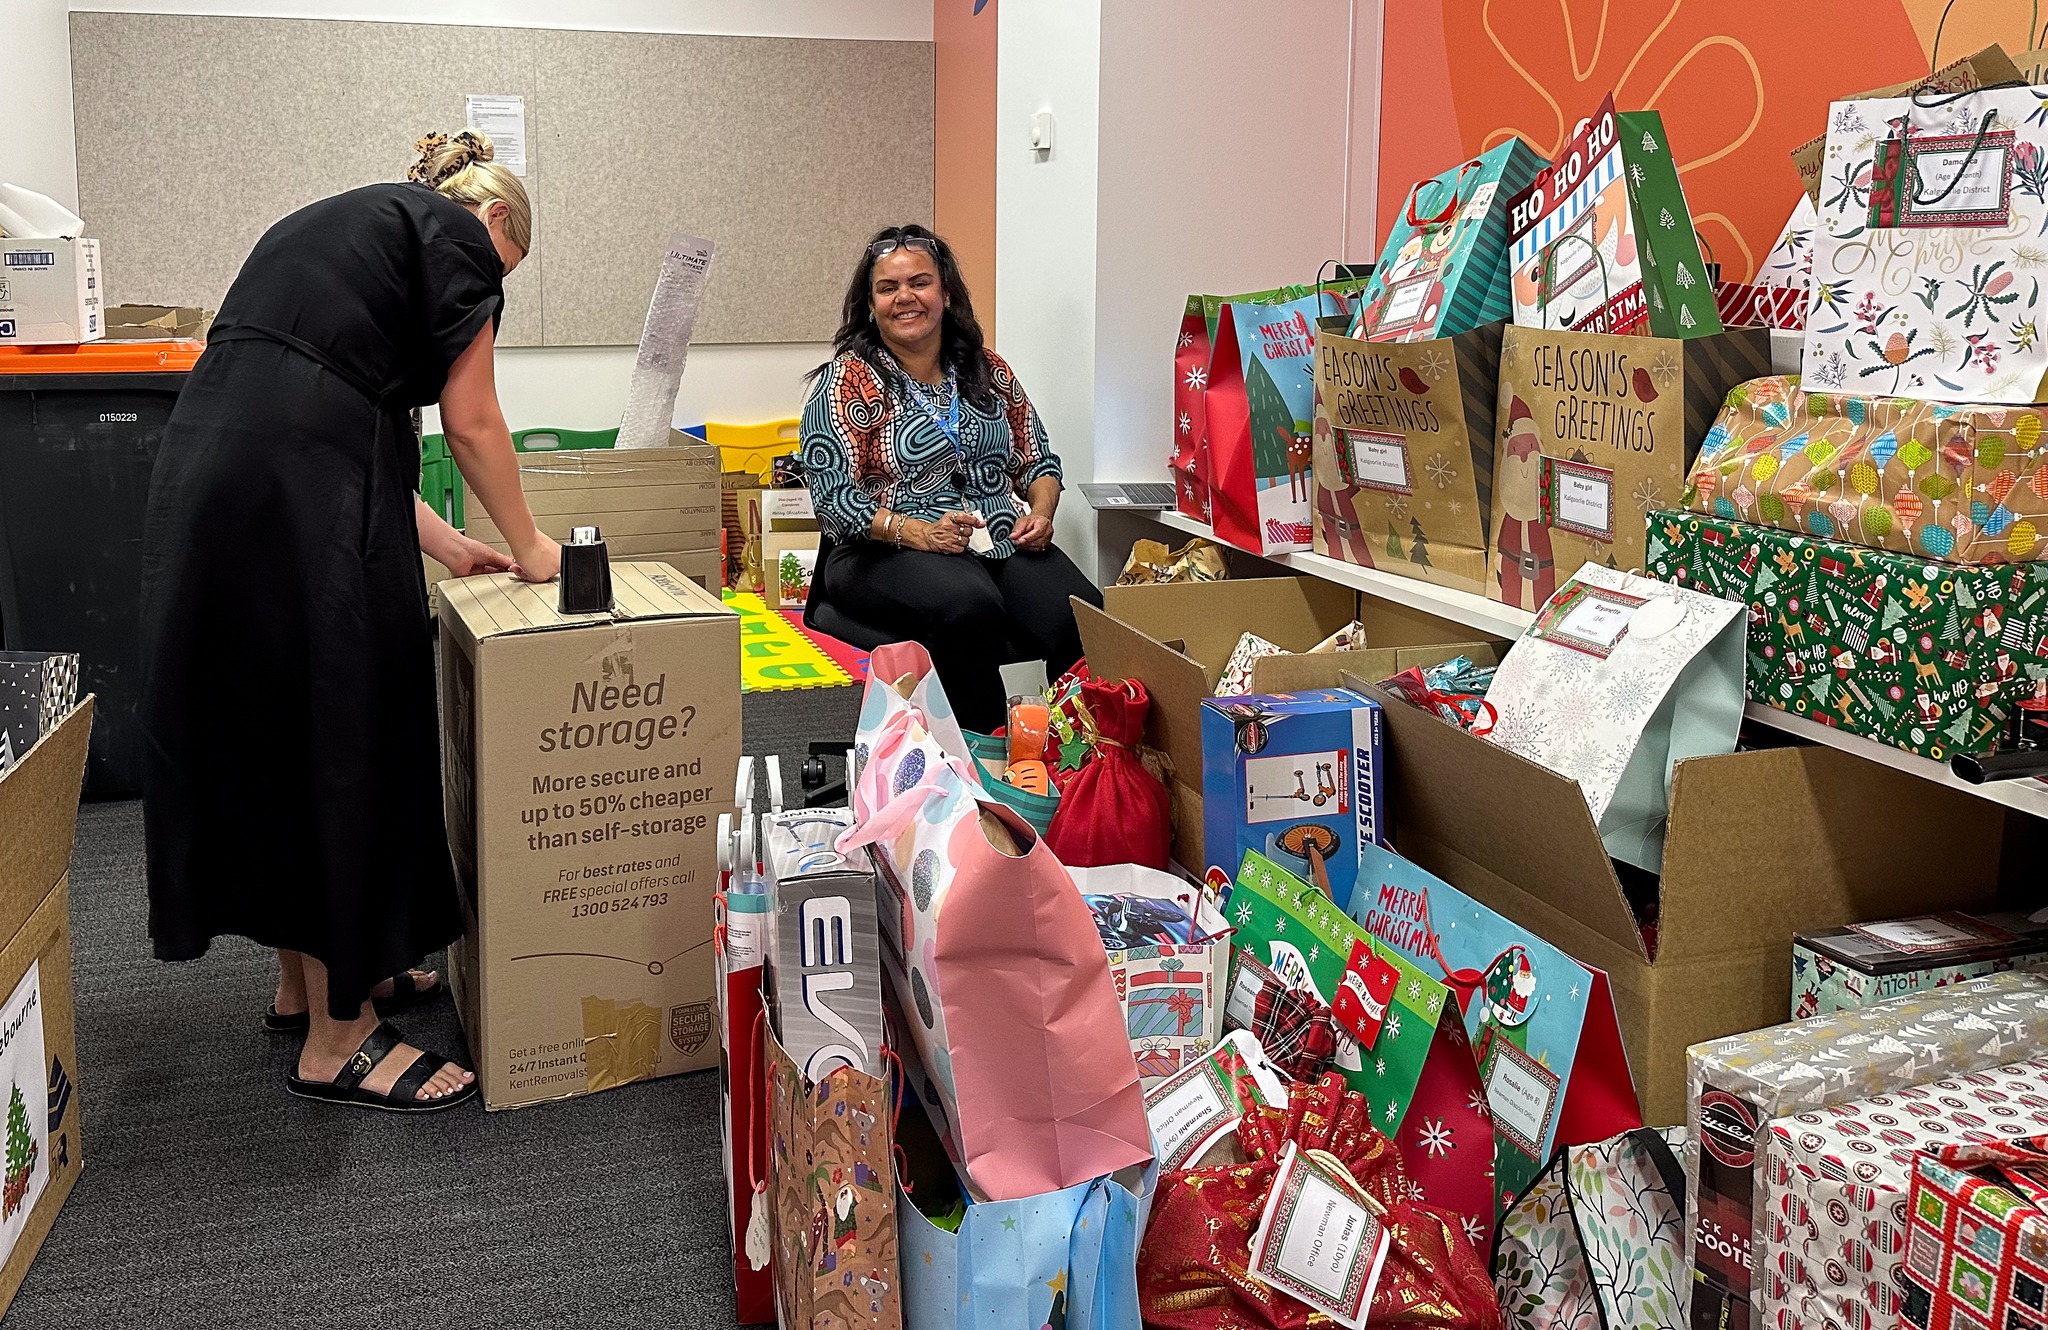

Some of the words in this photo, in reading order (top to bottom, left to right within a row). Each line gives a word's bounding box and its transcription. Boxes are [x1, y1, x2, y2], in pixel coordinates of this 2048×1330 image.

[1512, 188, 1545, 235] HO
[1553, 151, 1581, 201] HO
[1587, 111, 1613, 165] HO
[1963, 186, 1991, 194] District
[1322, 345, 1399, 392] EASON'S
[1532, 345, 1629, 398] SEASON'S
[99, 412, 138, 423] 0150229
[1338, 390, 1440, 433] GREETINGS
[1555, 395, 1656, 453] GREETINGS
[1367, 446, 1380, 455] Baby
[1573, 481, 1584, 491] Baby
[1584, 484, 1593, 492] girl
[680, 506, 716, 515] DESTINATION
[1584, 498, 1603, 510] District
[1707, 550, 1735, 571] MERRY
[1825, 579, 1858, 604] MERRY
[1812, 643, 1828, 661] HO
[1809, 662, 1827, 674] HO
[571, 673, 666, 714] Need
[1952, 679, 1970, 698] HO
[1948, 698, 1968, 716] HO
[538, 705, 696, 753] storage?
[1853, 706, 1896, 745] FALALA
[532, 770, 586, 795] More
[590, 762, 660, 788] secure
[663, 757, 702, 778] and
[1356, 747, 1372, 828] SCOOTER
[521, 806, 549, 826] up
[552, 801, 575, 821] to
[579, 794, 626, 816] 50%
[629, 784, 713, 811] cheaper
[527, 829, 578, 851] than
[581, 813, 707, 845] self-storage
[558, 866, 581, 883] For
[582, 861, 616, 879] best
[616, 858, 652, 876] rates
[654, 854, 681, 869] and
[543, 887, 578, 904] FREE
[579, 878, 628, 900] special
[630, 874, 670, 892] offers
[672, 870, 696, 886] call
[572, 901, 609, 919] 1300
[611, 896, 641, 914] 524
[642, 892, 669, 908] 793
[1378, 883, 1424, 922] MERRY
[1273, 950, 1309, 990] MERRY
[672, 1012, 710, 1026] SECURE
[672, 1023, 710, 1037] STORAGE
[509, 1048, 528, 1059] Get
[530, 1047, 536, 1056] a
[538, 1042, 560, 1054] free
[509, 1062, 536, 1075] 24/7
[538, 1055, 578, 1070] Instant
[1502, 1072, 1520, 1092] Rosalie
[1522, 1088, 1534, 1102] (Age
[1174, 1094, 1204, 1117] Newman
[1156, 1116, 1174, 1133] Office
[1164, 1132, 1179, 1151] (9yo)
[1316, 1200, 1337, 1238] Newman
[1340, 1214, 1358, 1242] Jurias
[1306, 1239, 1323, 1267] Office
[1330, 1243, 1348, 1274] (10yo)
